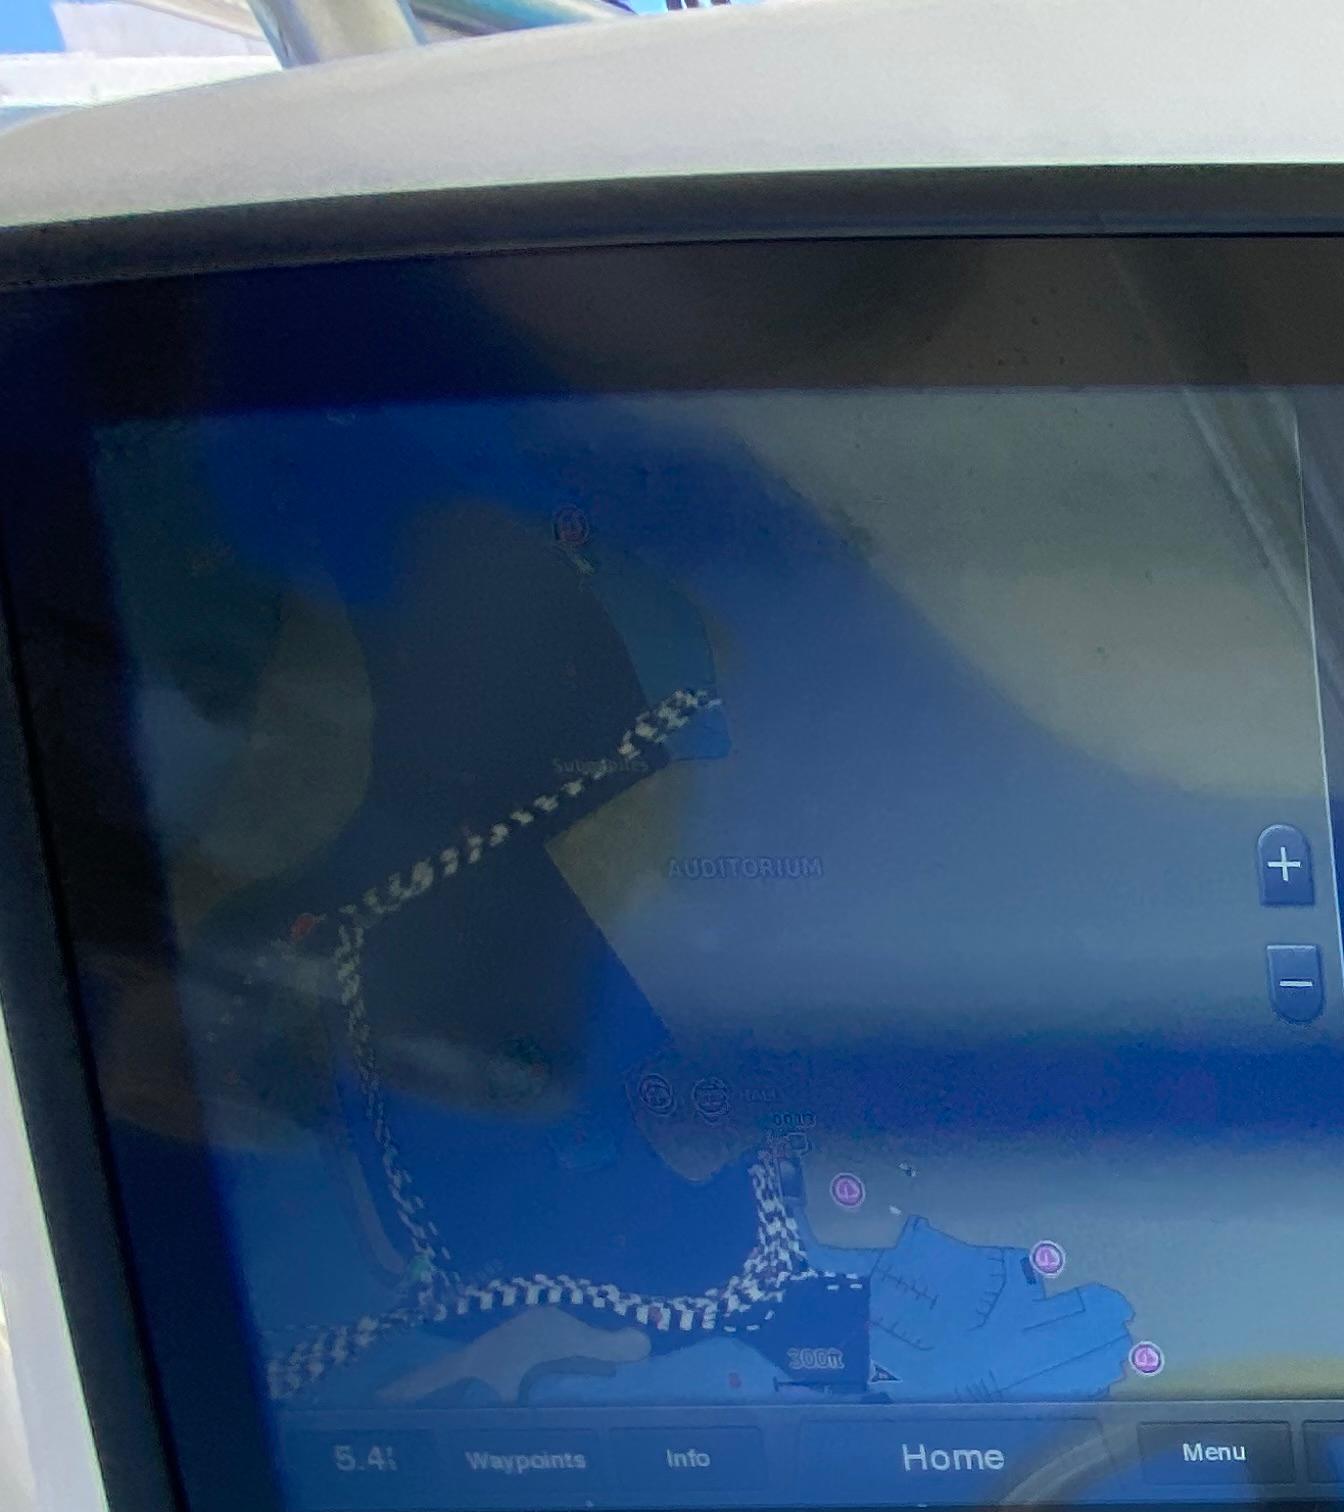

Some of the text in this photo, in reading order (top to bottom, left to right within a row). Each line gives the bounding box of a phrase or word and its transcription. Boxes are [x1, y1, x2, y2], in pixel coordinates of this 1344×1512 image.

[668, 857, 823, 878] AUDITORIUM
[465, 1451, 587, 1474] Waypoints
[666, 1449, 710, 1468] Info
[902, 1444, 1005, 1471] Home
[1183, 1442, 1246, 1462] Menu
